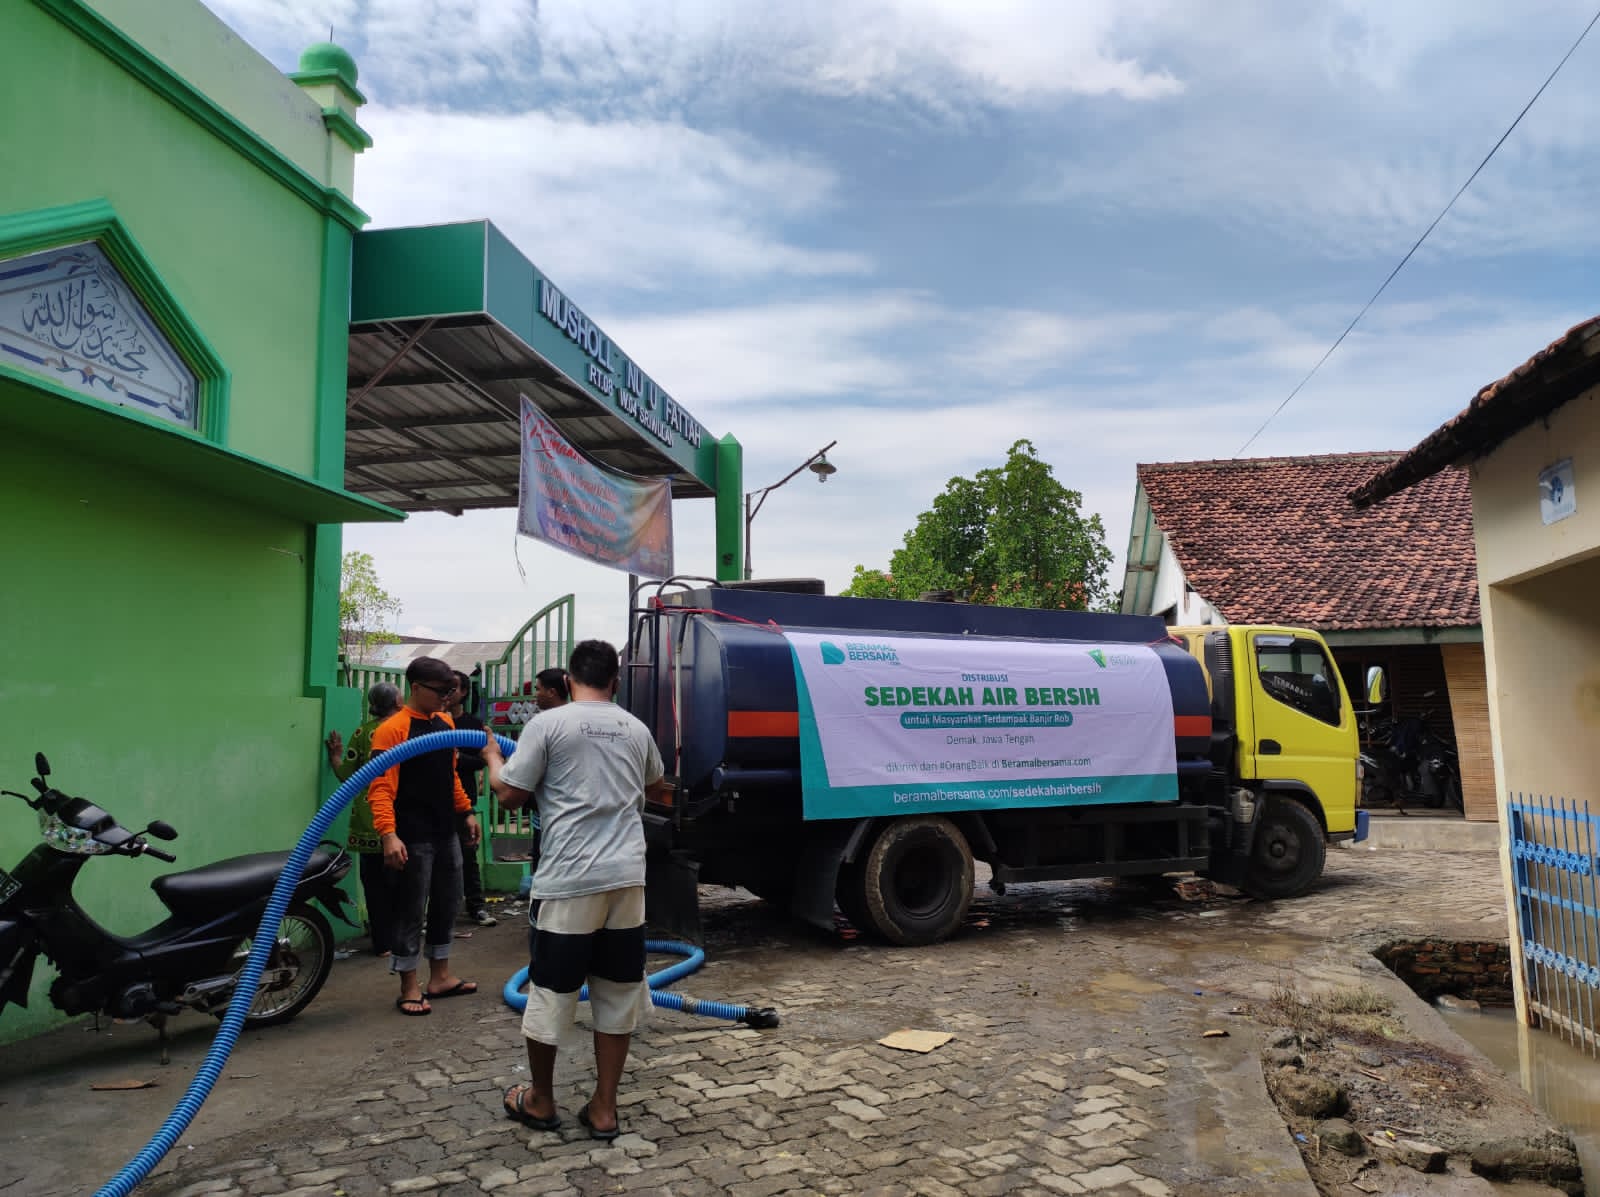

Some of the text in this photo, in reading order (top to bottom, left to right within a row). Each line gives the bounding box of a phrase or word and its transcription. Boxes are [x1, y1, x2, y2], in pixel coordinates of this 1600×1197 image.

[666, 397, 701, 449] FATTAH
[848, 651, 899, 662] BERSAMA
[961, 673, 1009, 683] DISTRIBUSI
[864, 686, 1101, 707] SEDEKAH AIR BERSIH
[904, 712, 1070, 727] untuk Masyarakat Terdampak Banjir Rob
[893, 782, 1102, 804] beramalbersama.com/sedekahairbersih
